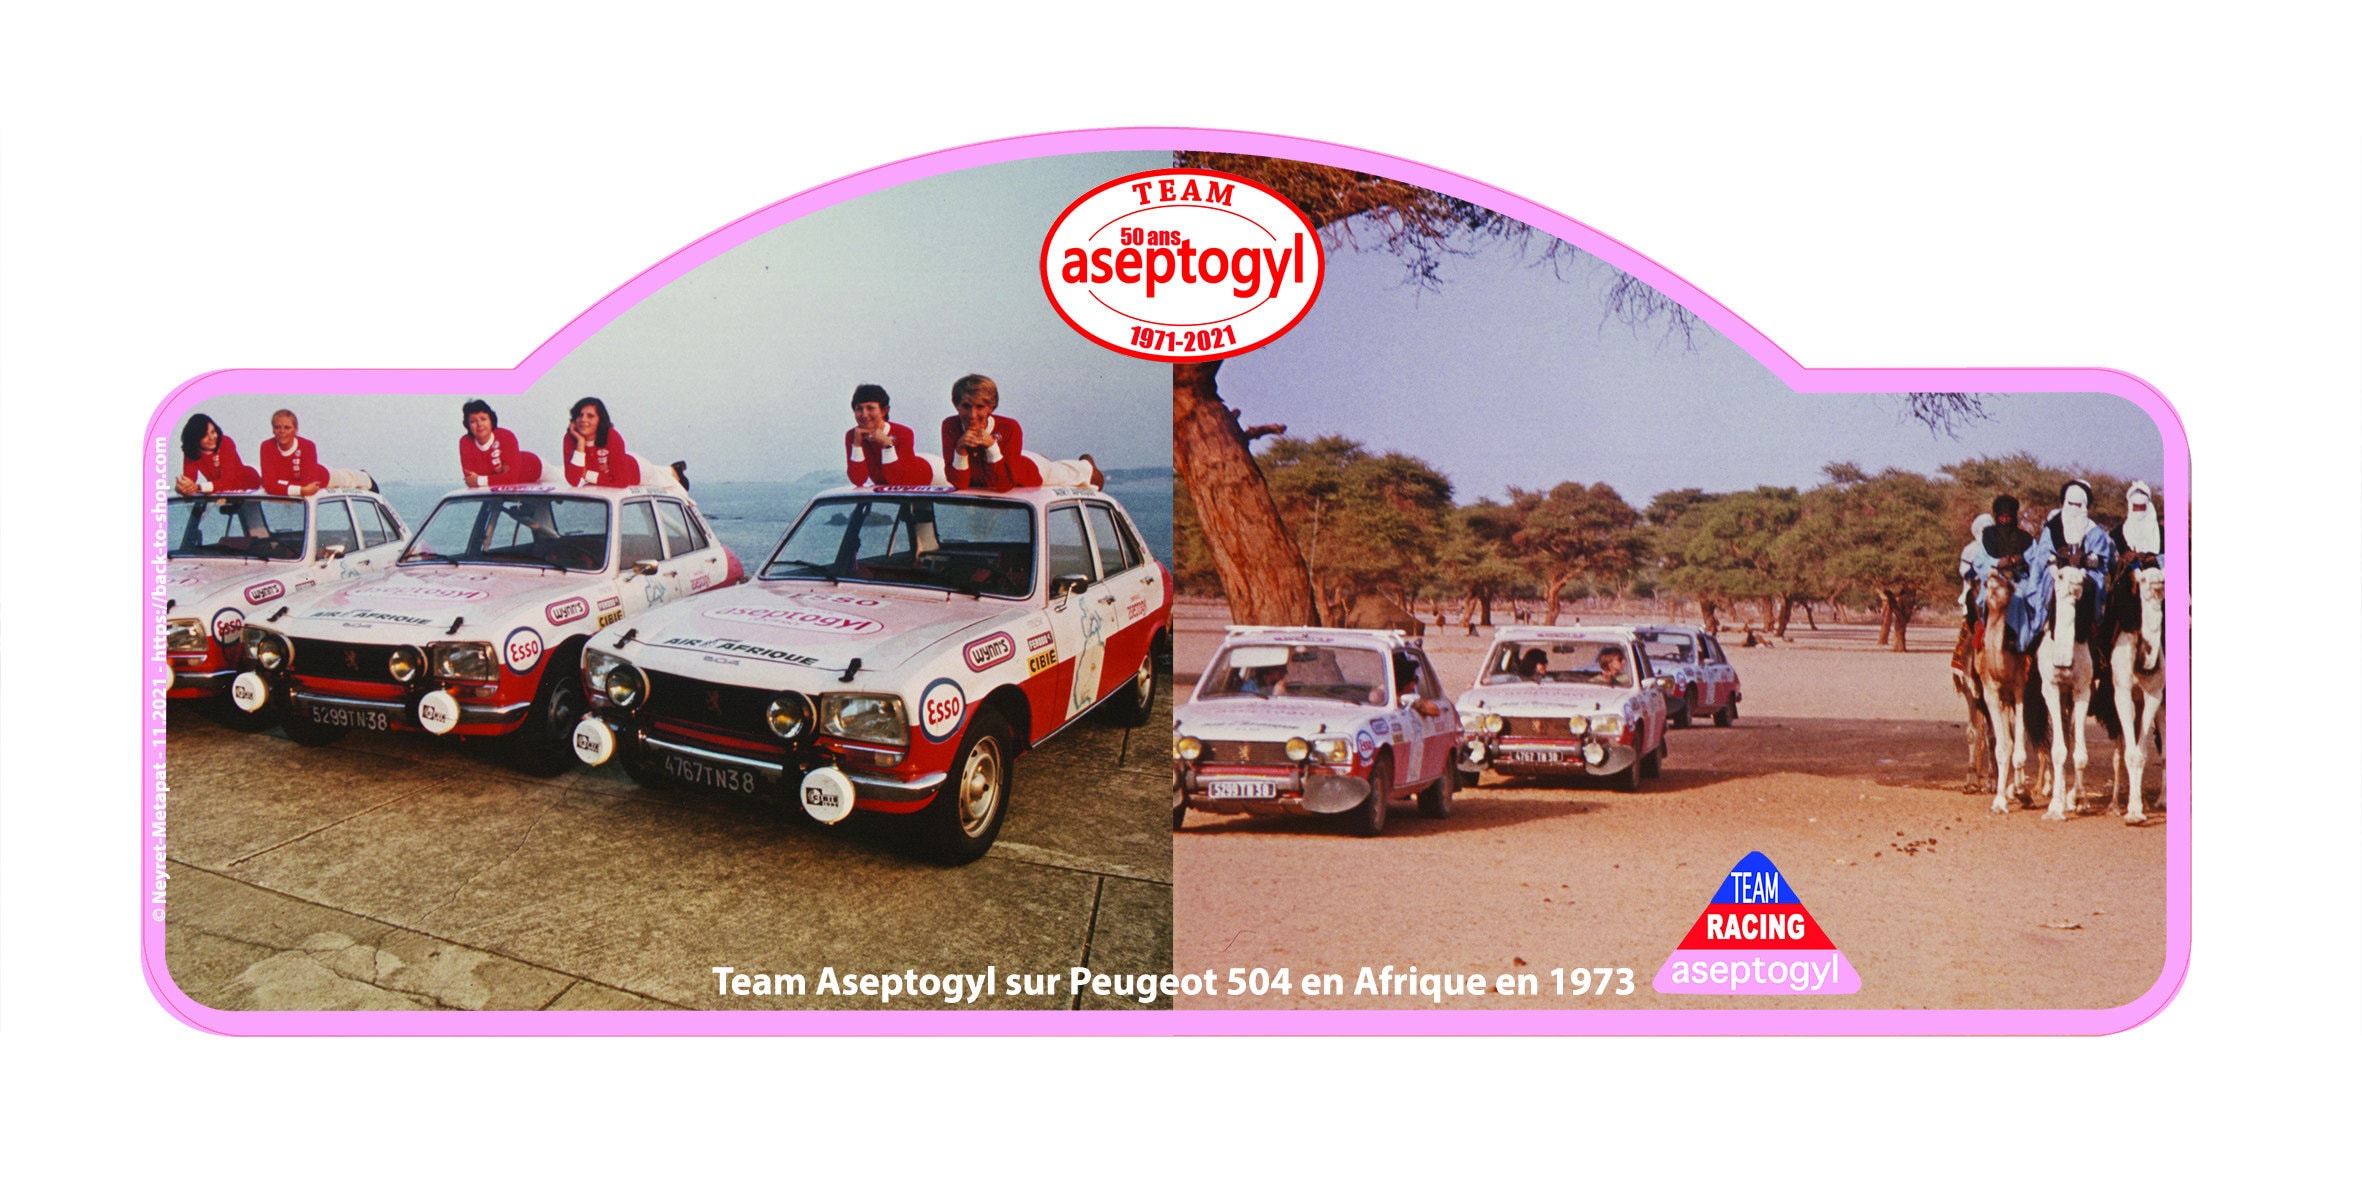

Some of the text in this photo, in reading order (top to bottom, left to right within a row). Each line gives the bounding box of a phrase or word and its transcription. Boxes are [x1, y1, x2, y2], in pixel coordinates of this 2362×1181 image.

[664, 637, 820, 666] AIR AFRIQUE
[1029, 648, 1057, 673] CIBIE
